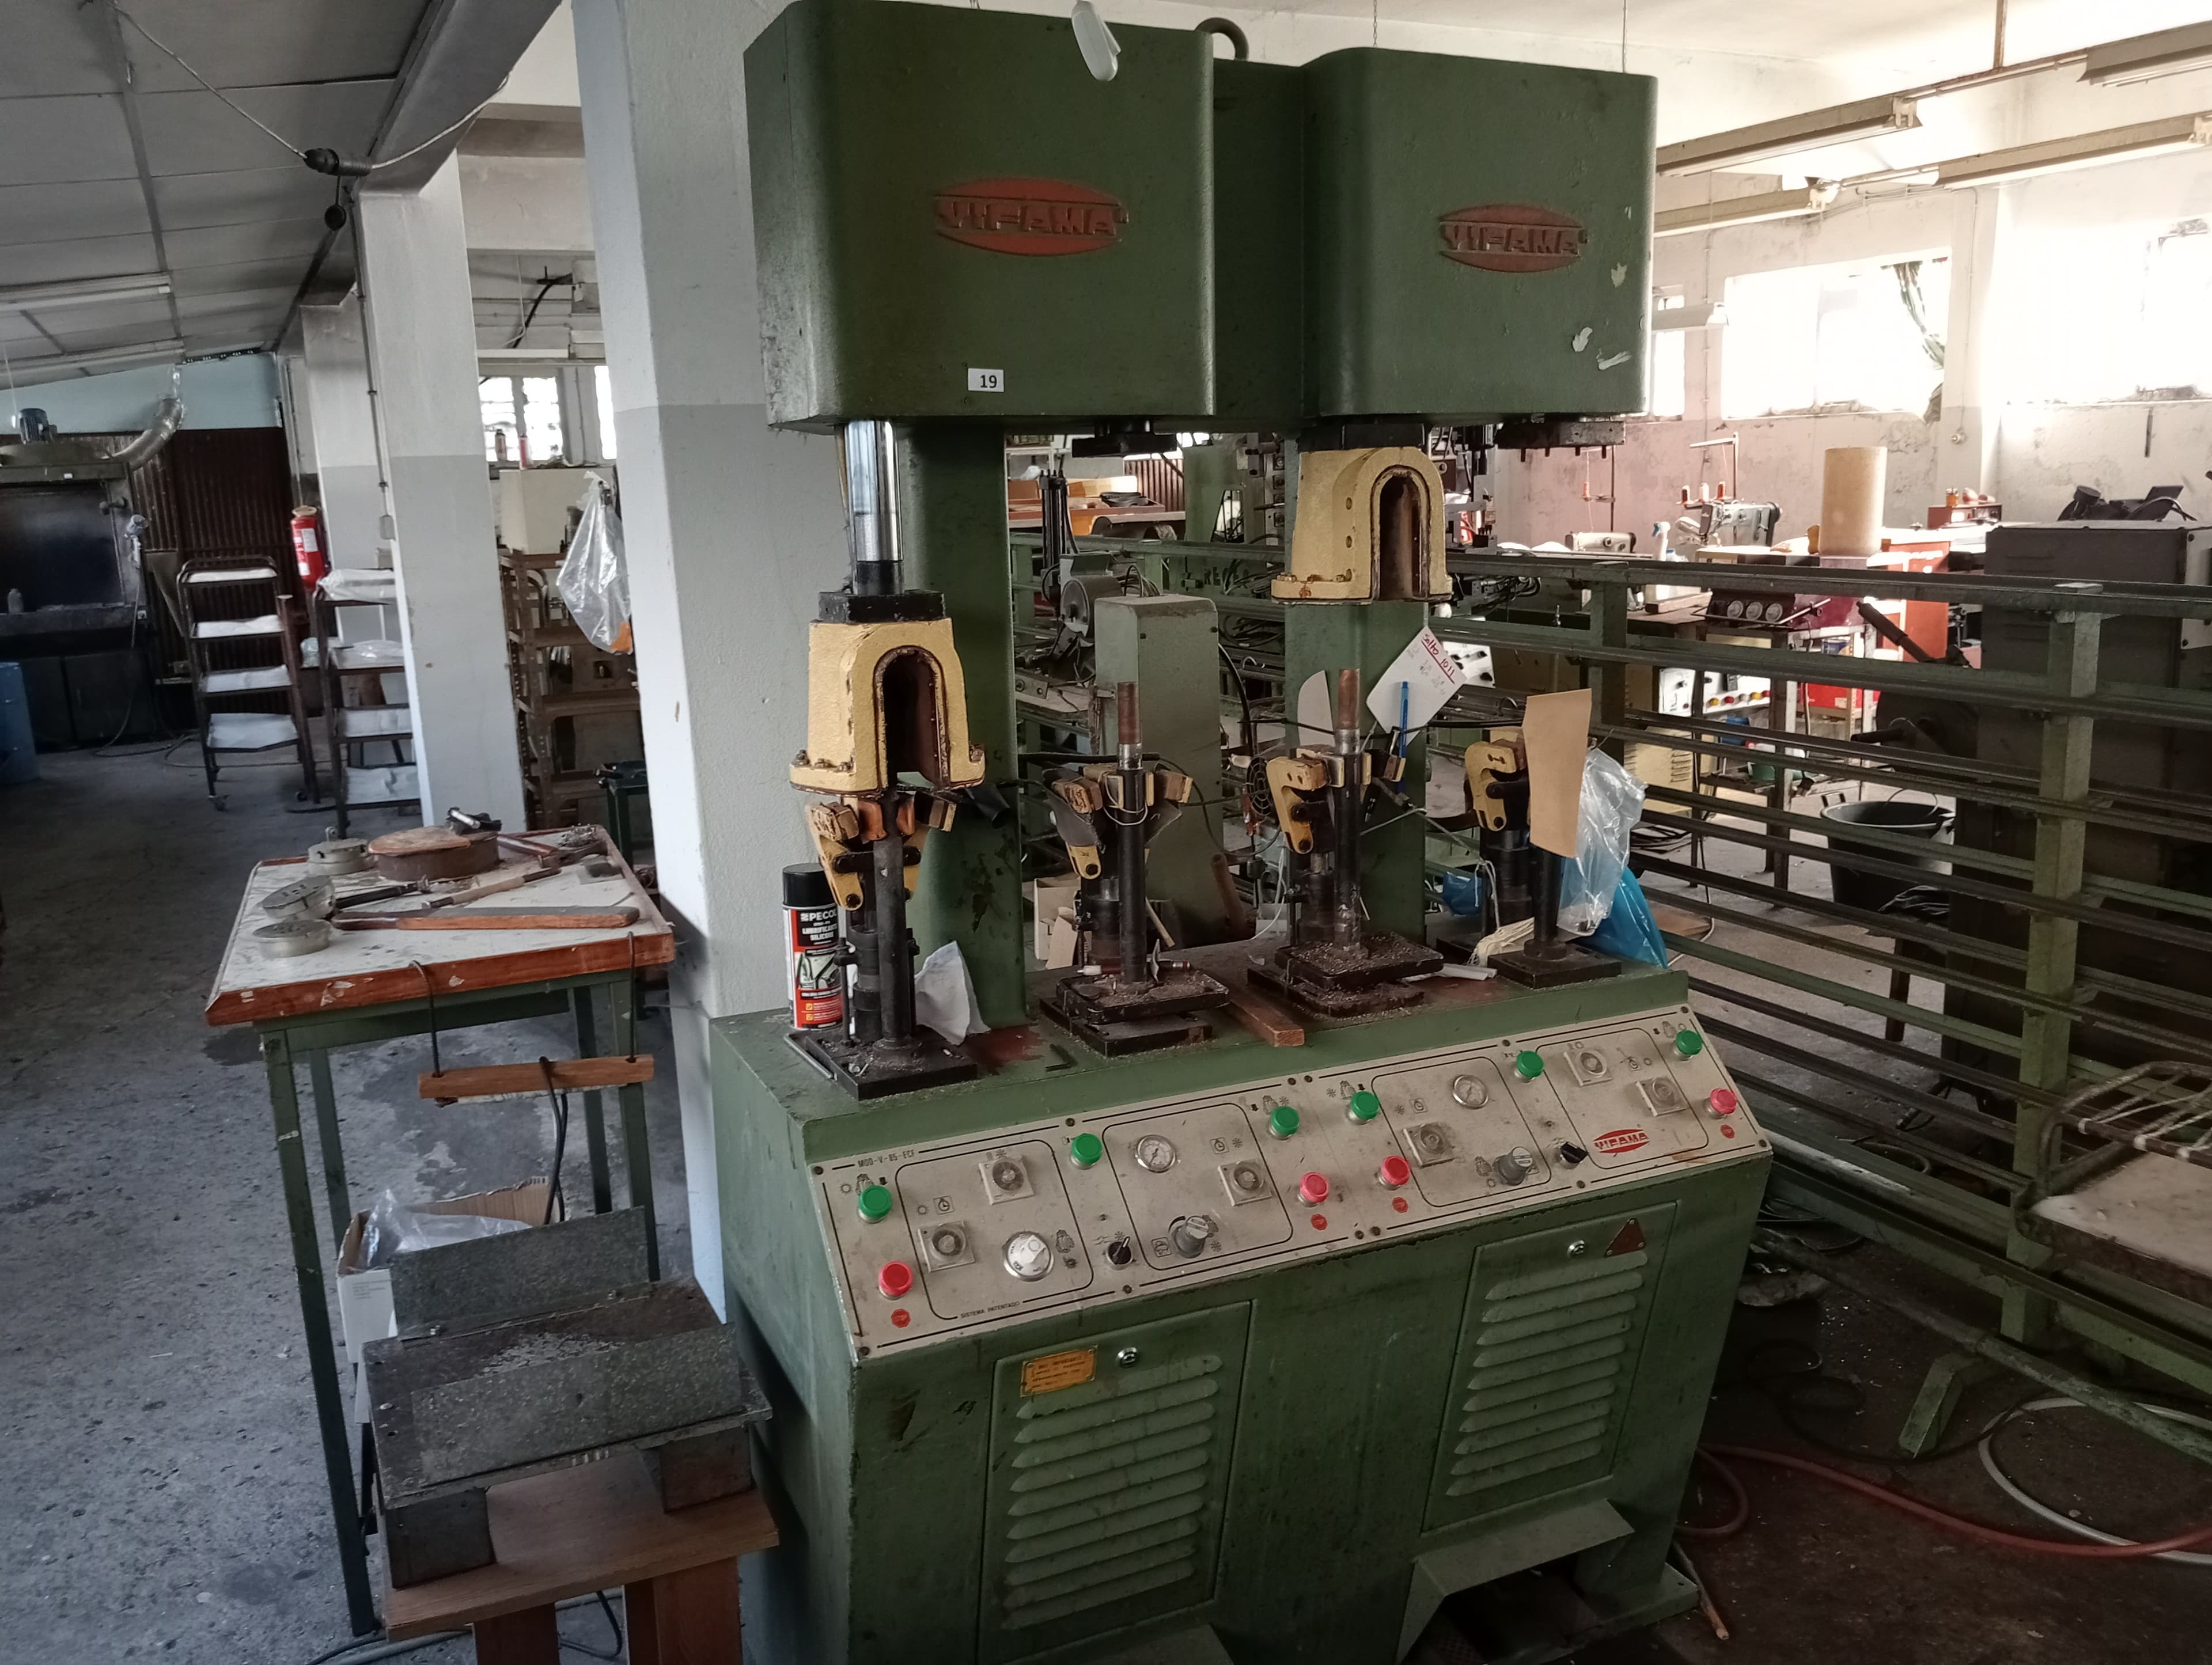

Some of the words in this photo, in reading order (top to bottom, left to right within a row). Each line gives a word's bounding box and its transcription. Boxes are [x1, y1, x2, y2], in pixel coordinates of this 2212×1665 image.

[980, 375, 997, 388] 19
[1594, 1132, 1648, 1150] VIFAMA
[960, 1309, 985, 1318] SISTEMA
[987, 1302, 1020, 1312] PATENTADO
